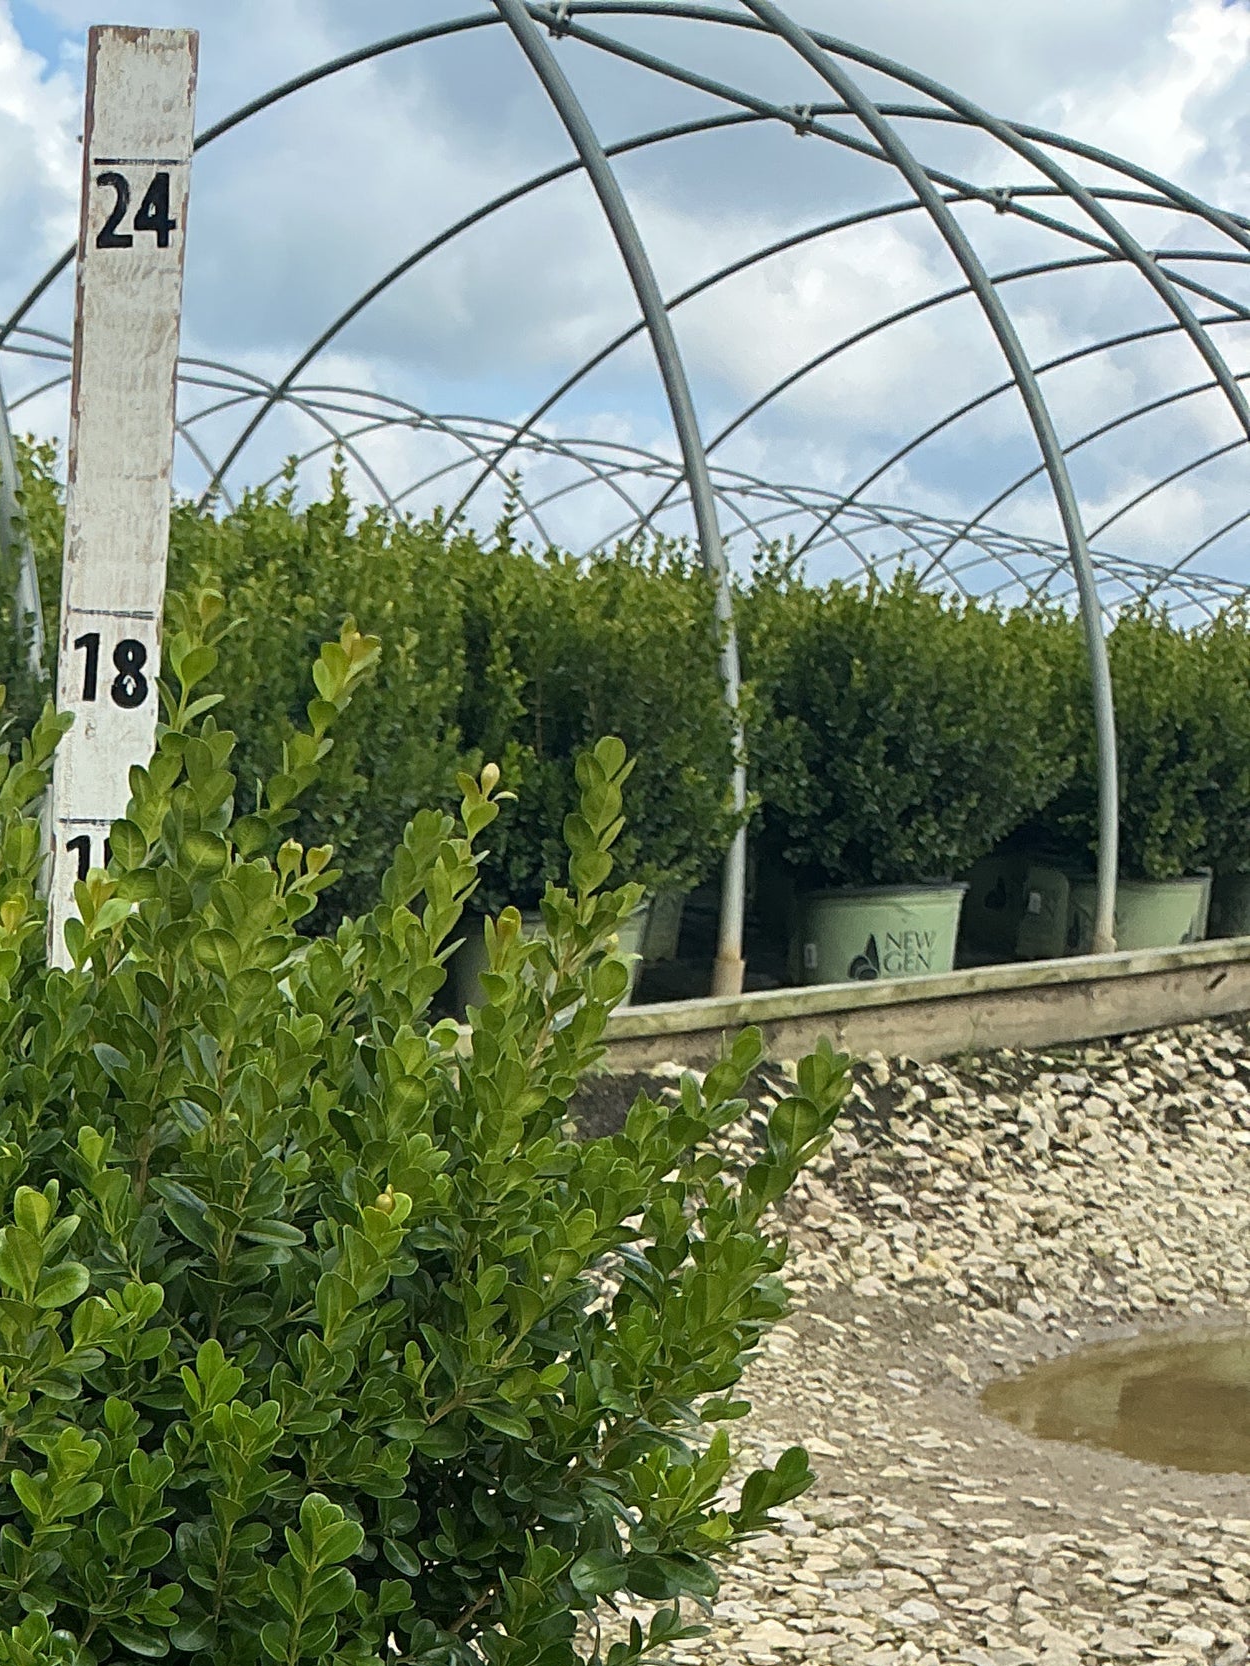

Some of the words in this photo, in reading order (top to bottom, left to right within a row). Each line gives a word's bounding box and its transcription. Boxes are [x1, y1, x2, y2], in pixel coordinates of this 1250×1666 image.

[96, 171, 176, 249] 24
[74, 632, 148, 709] 18
[883, 951, 931, 973] GEN
[885, 931, 936, 950] NEW
